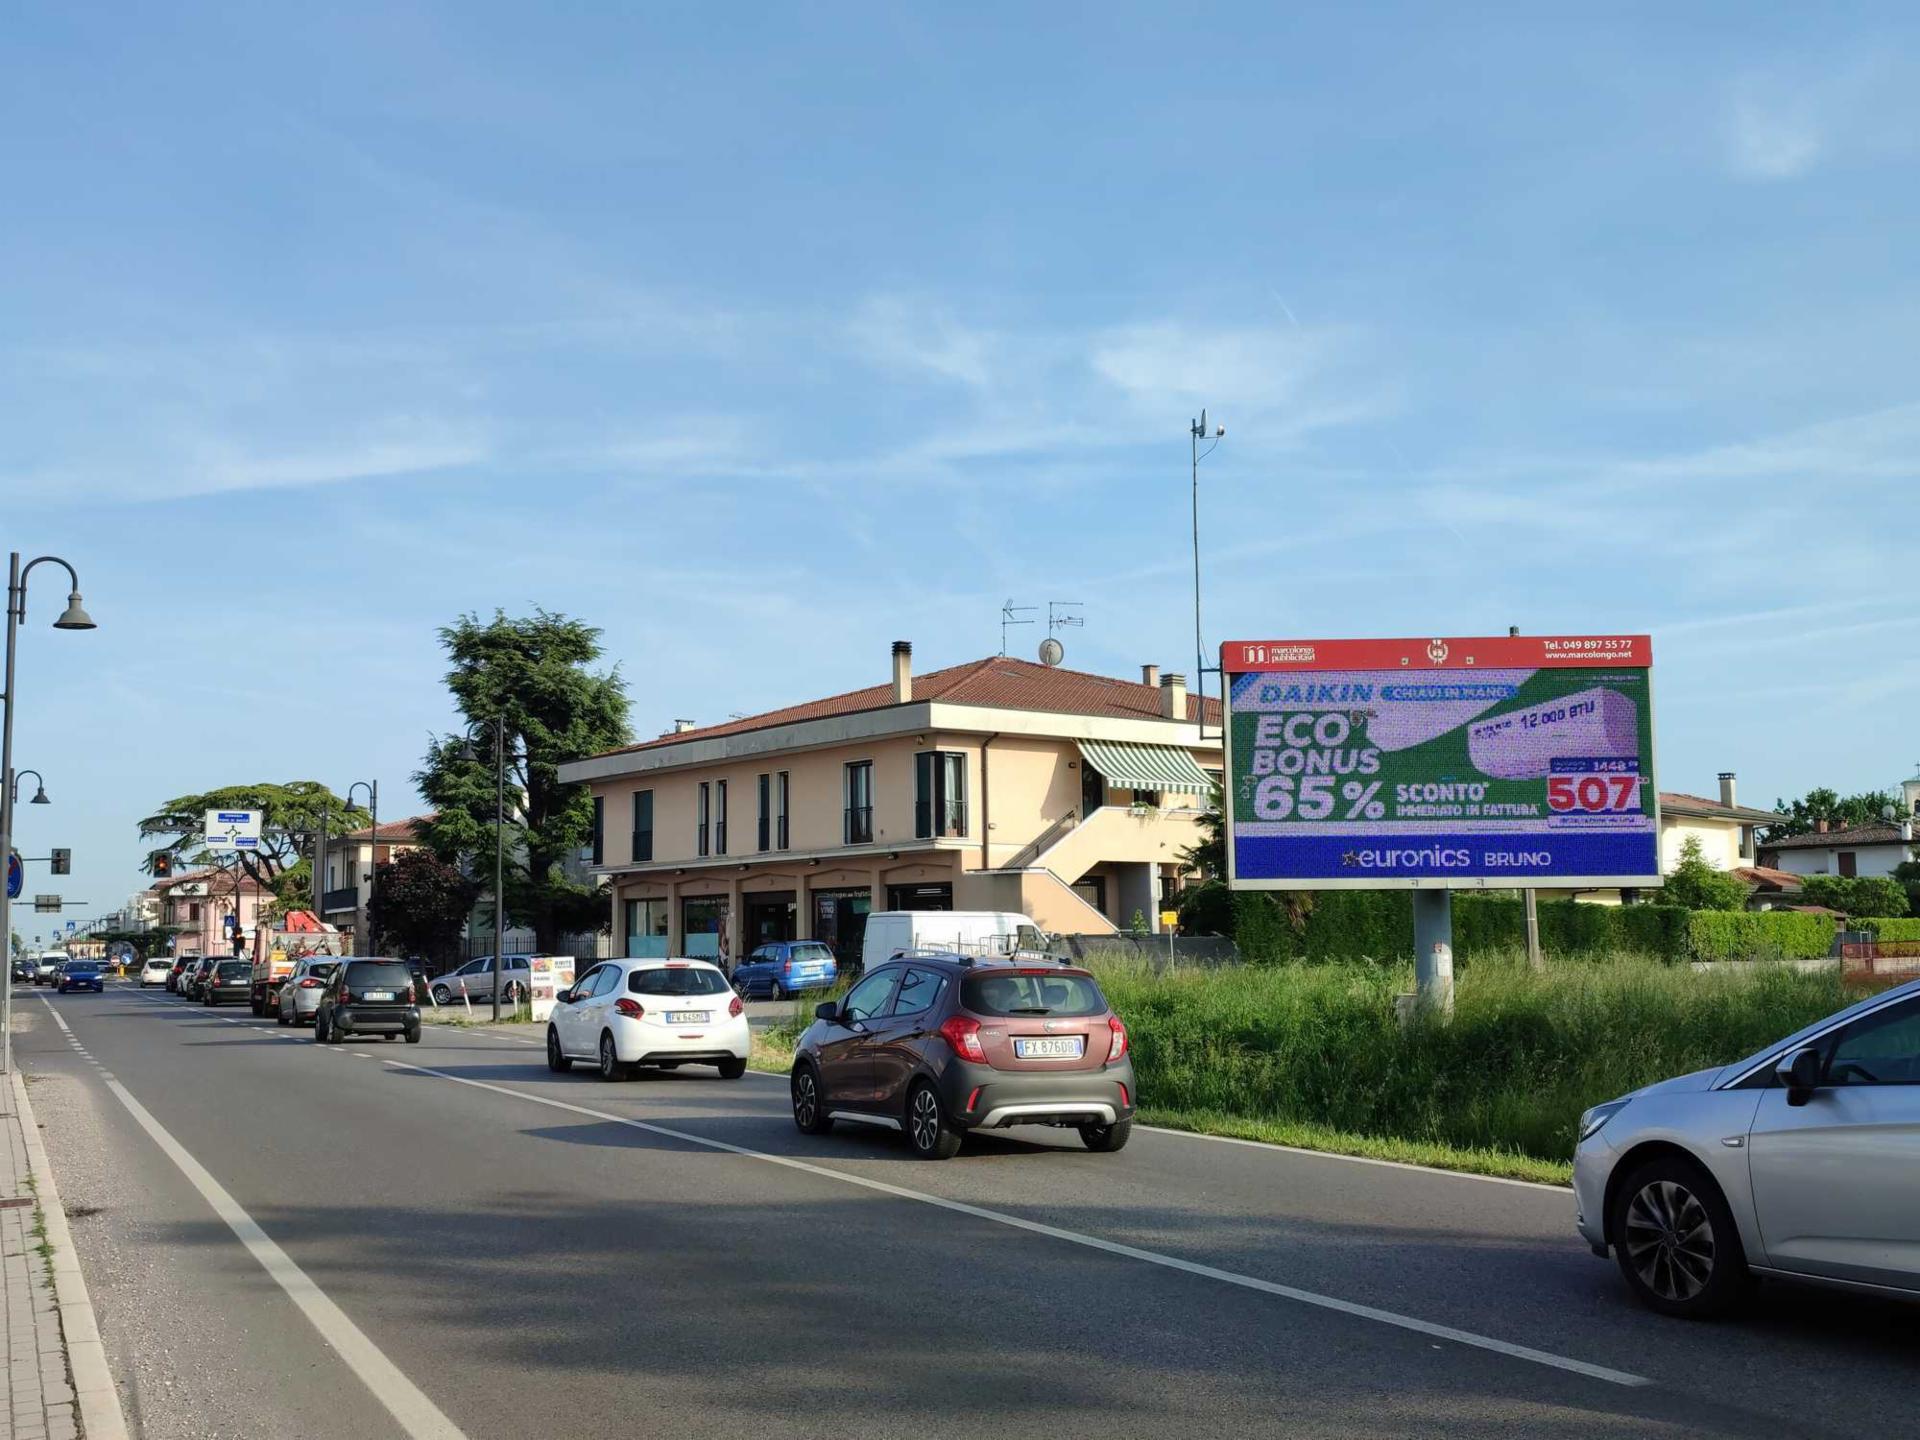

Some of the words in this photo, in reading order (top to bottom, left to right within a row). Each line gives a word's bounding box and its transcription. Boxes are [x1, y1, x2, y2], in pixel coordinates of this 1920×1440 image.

[1271, 645, 1315, 655] marcolongo
[1543, 641, 1561, 650] Tel.
[1563, 640, 1582, 650] 049
[1584, 640, 1602, 649] 897
[1605, 640, 1618, 649] 55
[1619, 640, 1632, 649] 77
[1545, 651, 1632, 660] www.marcolongo.net
[1261, 684, 1374, 702] DAIKIN
[1520, 709, 1566, 729] 12.000
[1569, 700, 1596, 718] BTU
[1255, 713, 1350, 747] ECO
[1251, 749, 1381, 776] BONUS
[1547, 776, 1637, 811] 507
[1396, 804, 1463, 817] IMMEDIATO
[1466, 804, 1480, 816] IN
[1359, 844, 1471, 868] euronics
[1484, 851, 1552, 867] BRUNO
[1024, 1041, 1038, 1054] FX
